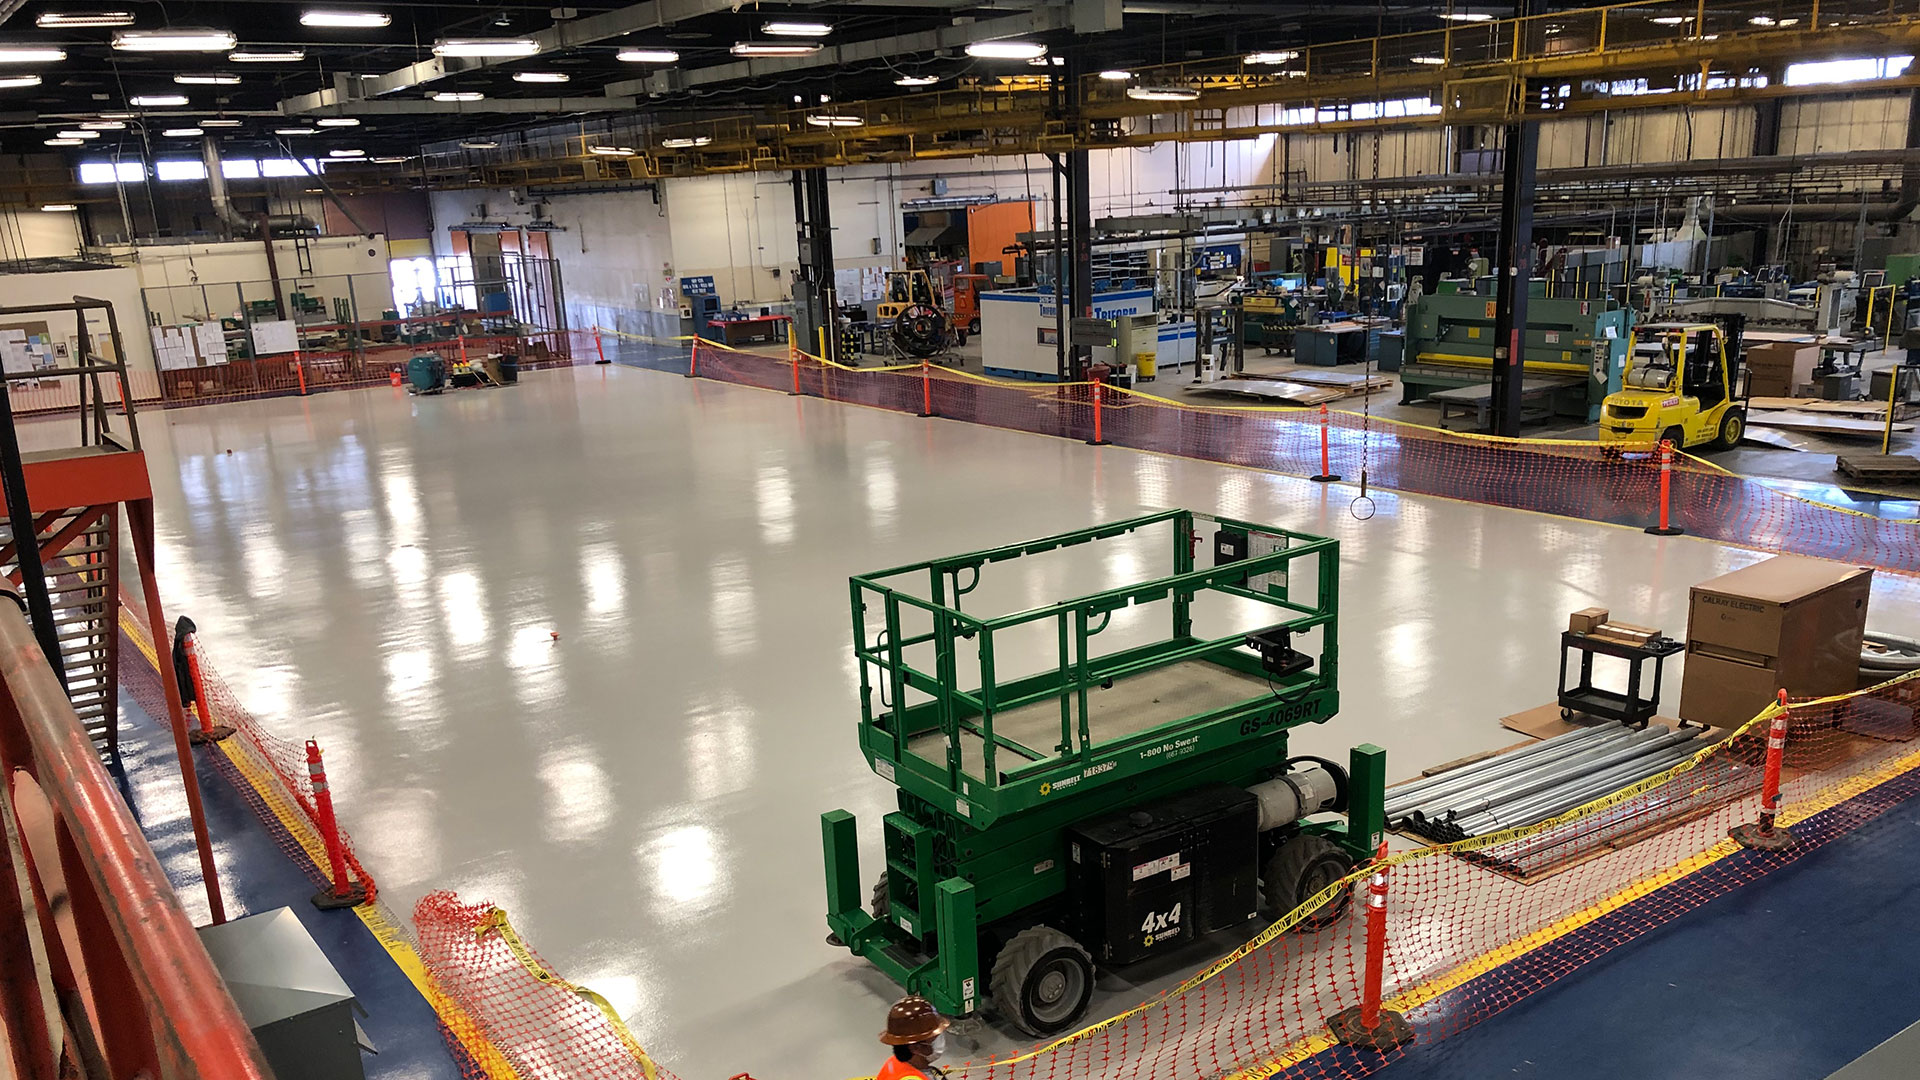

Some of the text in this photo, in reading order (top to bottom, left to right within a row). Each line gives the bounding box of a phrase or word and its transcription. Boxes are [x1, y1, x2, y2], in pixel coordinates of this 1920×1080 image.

[1094, 307, 1137, 319] TRIFORM
[1731, 600, 1765, 613] ELECTRIC
[1240, 698, 1322, 736] GS-4069RT
[1140, 747, 1162, 759] 1-800
[1163, 743, 1174, 753] No
[1141, 902, 1182, 934] 4x4
[1257, 920, 1288, 944] CUIDADO
[1300, 892, 1327, 915] CAUTION
